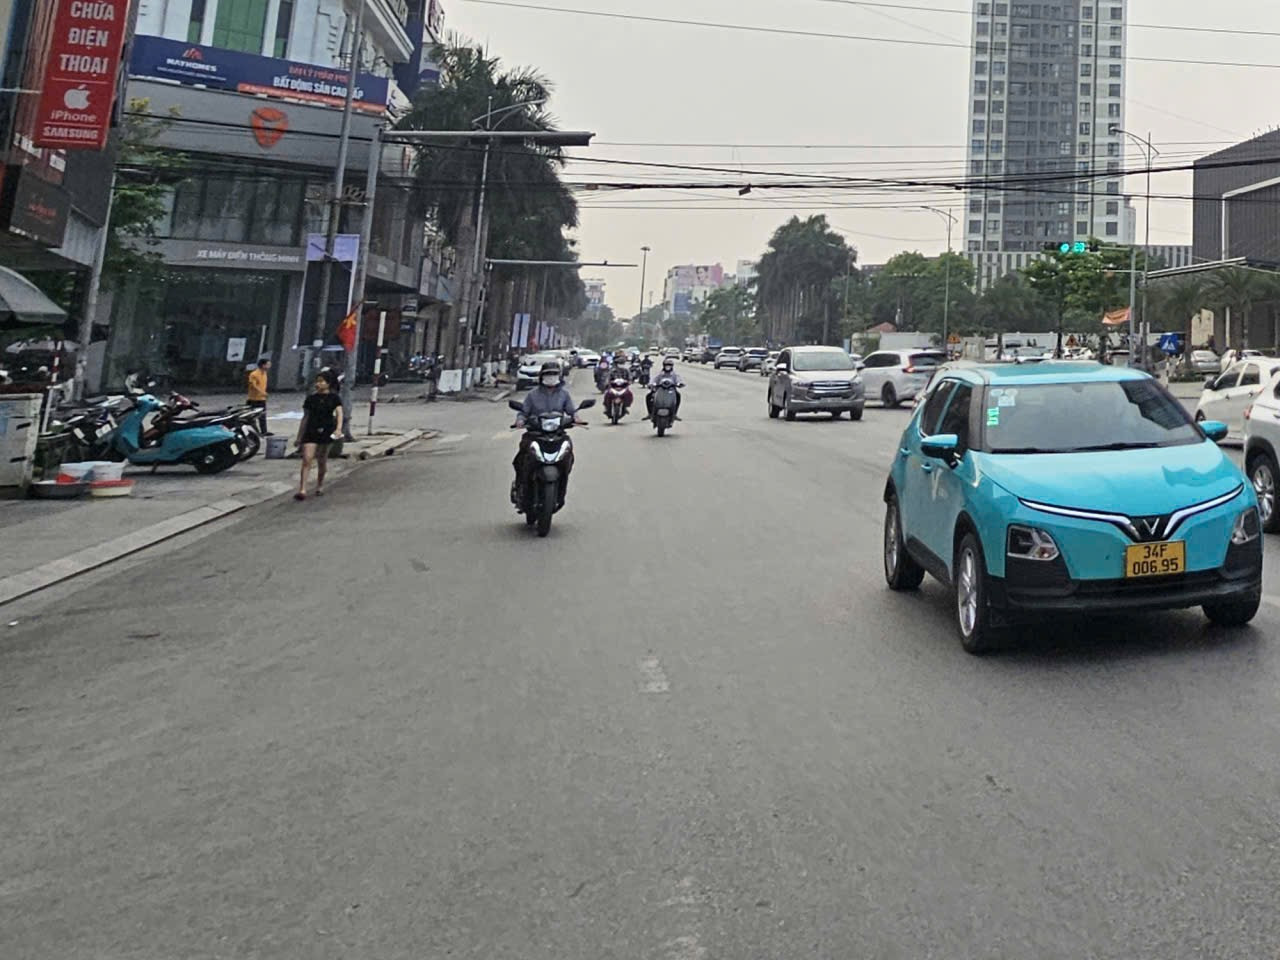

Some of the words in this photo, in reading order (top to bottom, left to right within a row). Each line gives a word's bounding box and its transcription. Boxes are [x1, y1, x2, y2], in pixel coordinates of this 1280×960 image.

[70, 0, 115, 21] CHỮA
[68, 26, 108, 50] ĐIỆN
[60, 53, 109, 77] THOẠI
[51, 110, 97, 121] iPhone
[43, 126, 98, 139] SAMSUNG
[1143, 545, 1167, 561] 34F
[1132, 558, 1179, 575] 006.95
